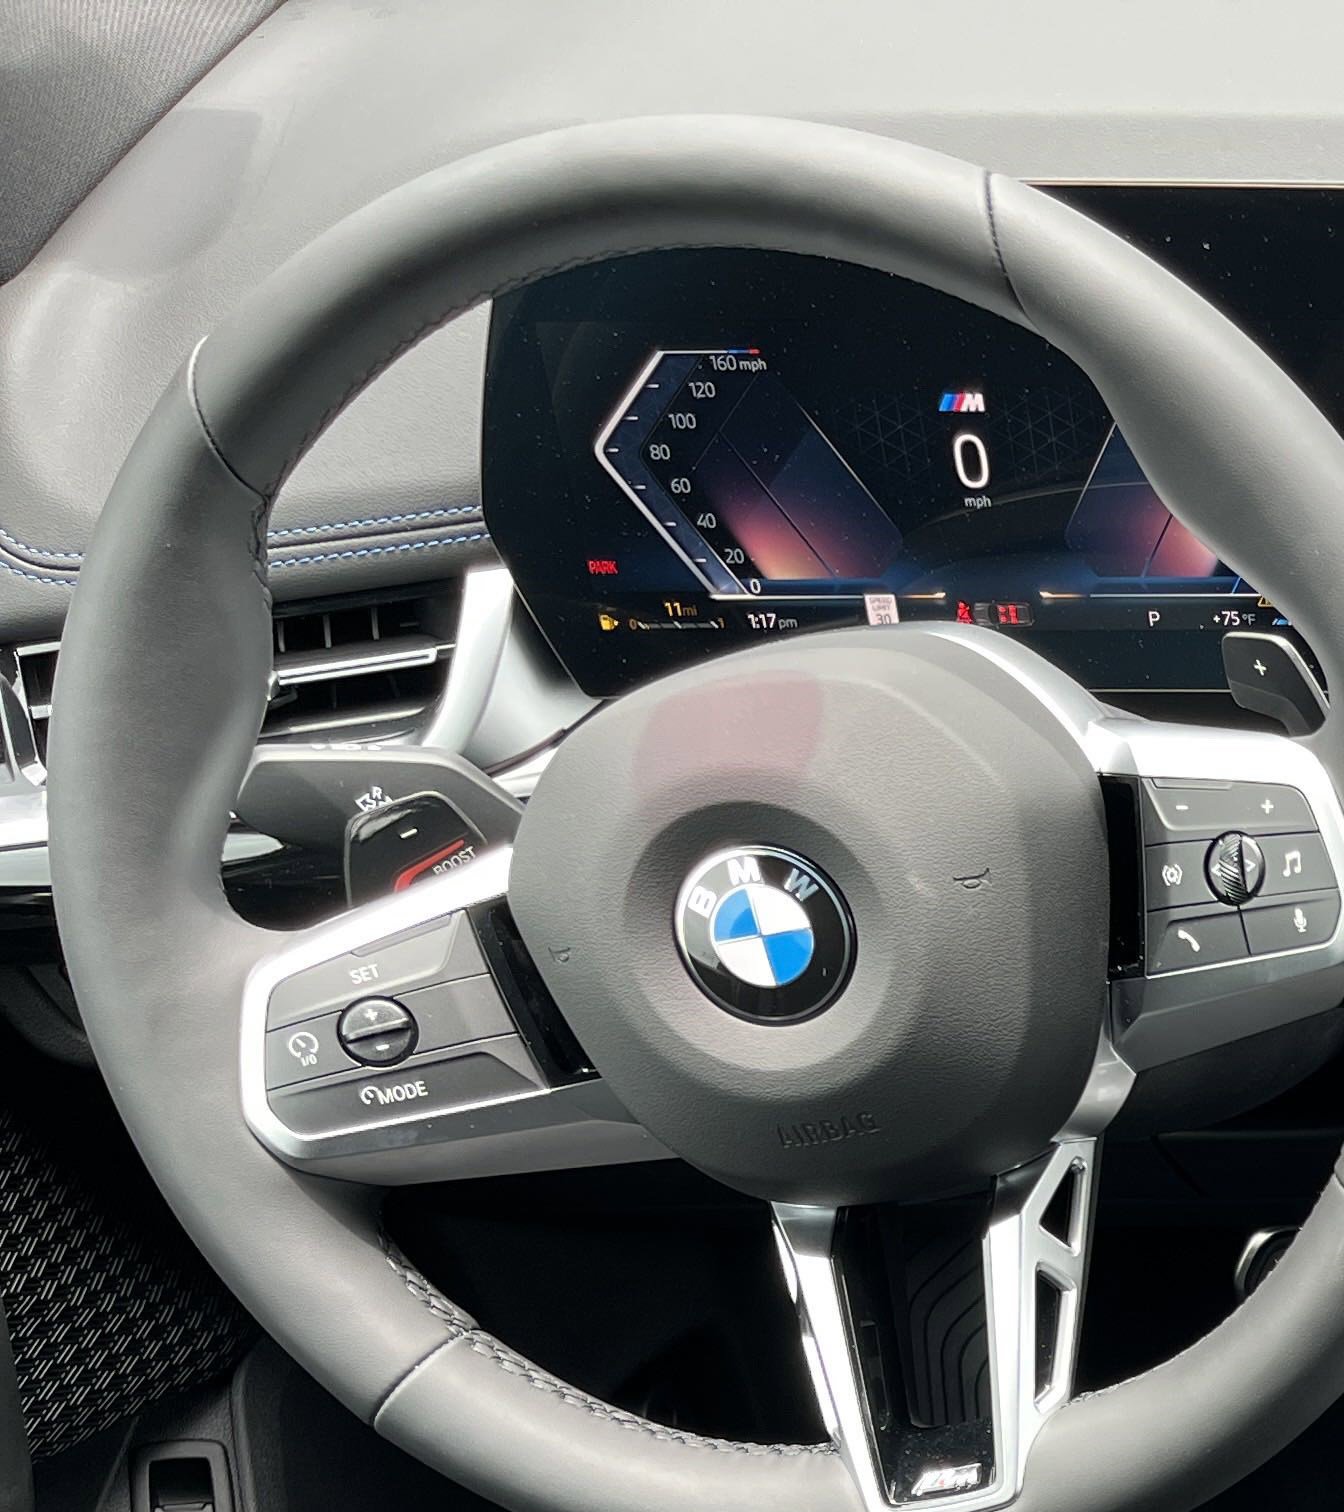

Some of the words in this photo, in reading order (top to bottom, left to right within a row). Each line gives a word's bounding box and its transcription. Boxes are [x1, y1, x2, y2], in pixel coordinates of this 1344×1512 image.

[709, 355, 737, 371] 160
[739, 358, 767, 373] mph
[688, 382, 716, 398] 120
[668, 413, 697, 430] 100
[649, 444, 671, 460] 80
[952, 433, 990, 490] 0
[671, 479, 691, 494] 60
[964, 496, 992, 511] mph
[697, 513, 717, 530] 40
[724, 548, 745, 564] 20
[588, 560, 618, 574] PARK
[750, 579, 761, 595] 0
[747, 613, 777, 629] 1:17
[778, 618, 798, 631] pm
[875, 613, 892, 625] 30
[1148, 611, 1160, 627] P
[432, 845, 477, 875] BOOST
[350, 963, 379, 985] SET
[378, 1081, 428, 1105] MODE
[777, 1111, 881, 1149] AIRBAG
